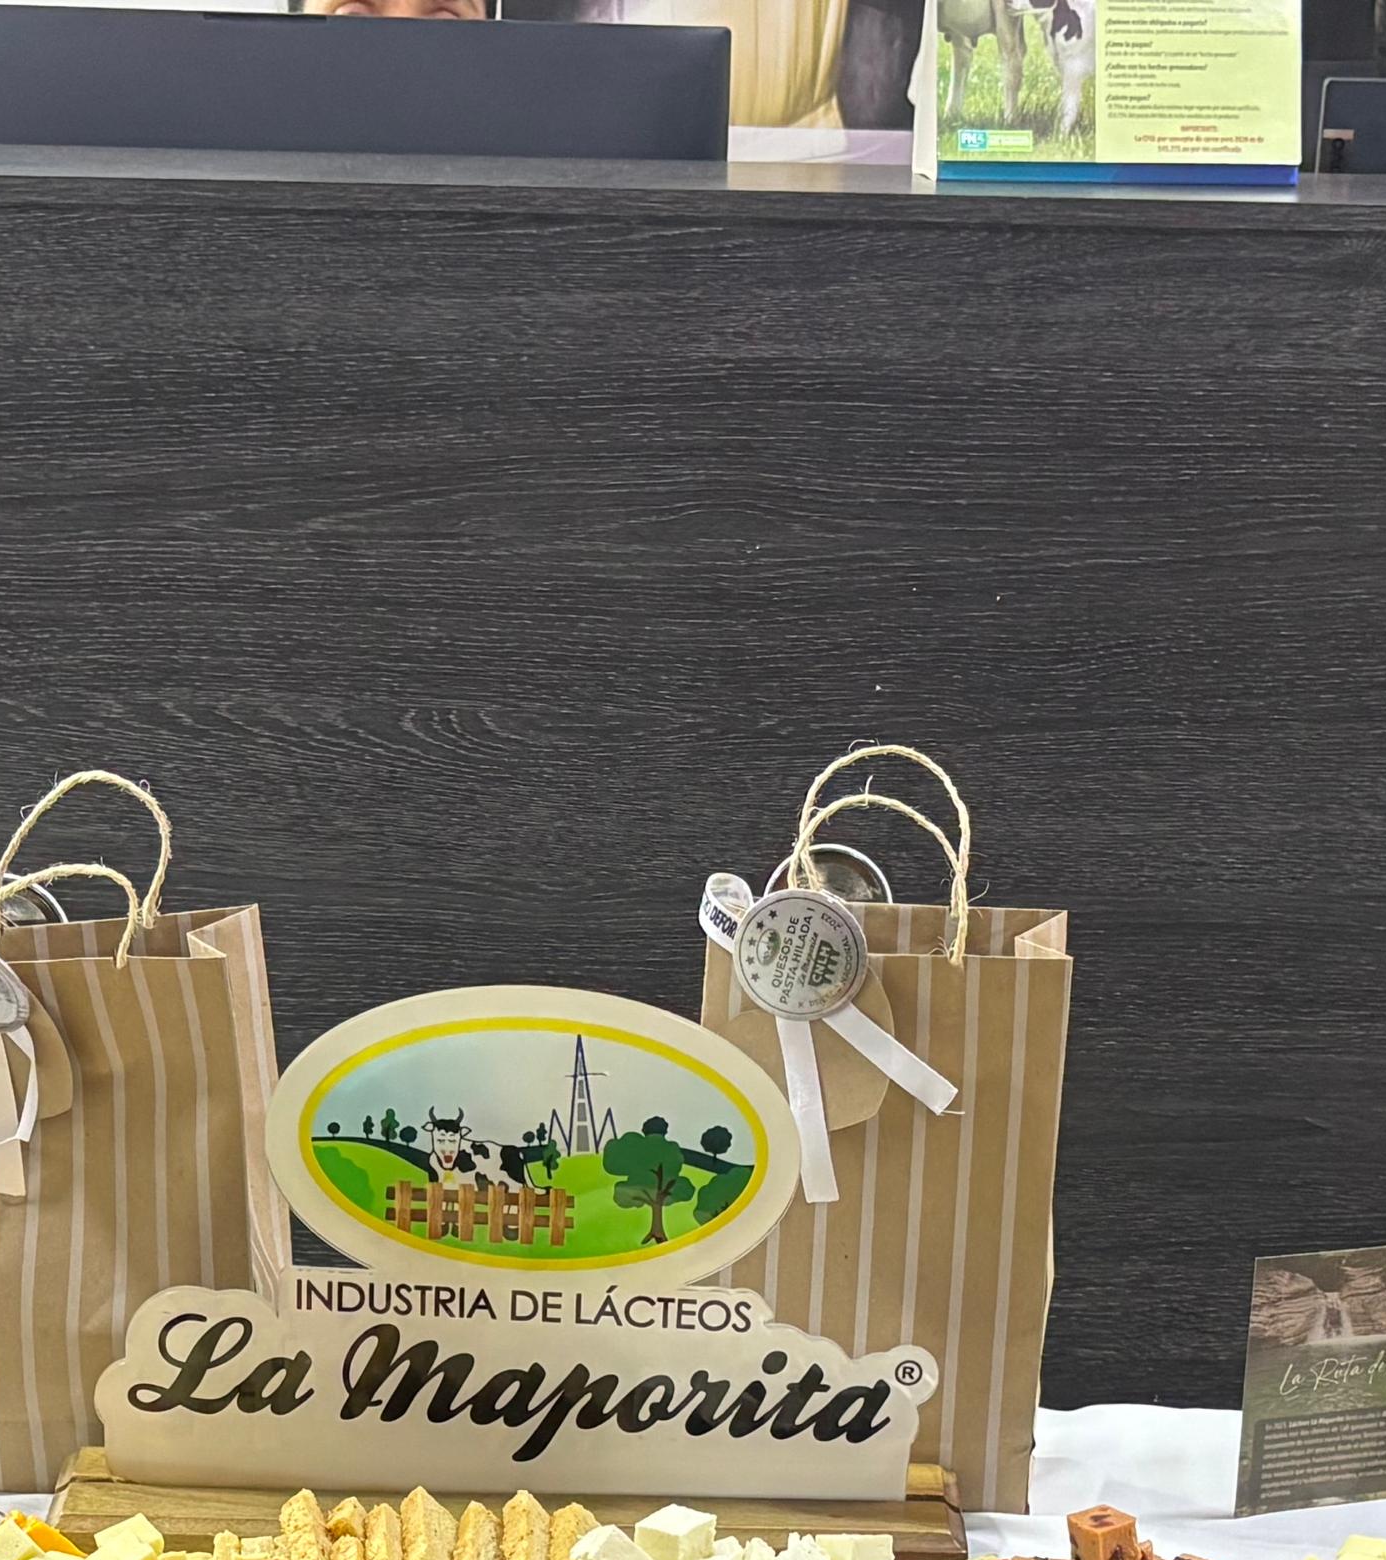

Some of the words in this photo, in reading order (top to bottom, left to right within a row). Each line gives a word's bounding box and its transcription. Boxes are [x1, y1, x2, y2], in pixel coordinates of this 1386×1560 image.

[772, 937, 794, 988] QUESOS
[787, 916, 800, 935] DE
[821, 912, 842, 932] 2023
[780, 965, 798, 1006] PASTA
[791, 915, 814, 963] HILADA
[296, 1279, 497, 1320] INDUSTRIA
[510, 1290, 564, 1323] DE
[575, 1285, 752, 1334] LÁCTEOS
[127, 1313, 315, 1416] La
[1279, 1363, 1304, 1396] La
[1310, 1355, 1368, 1391] Ruta
